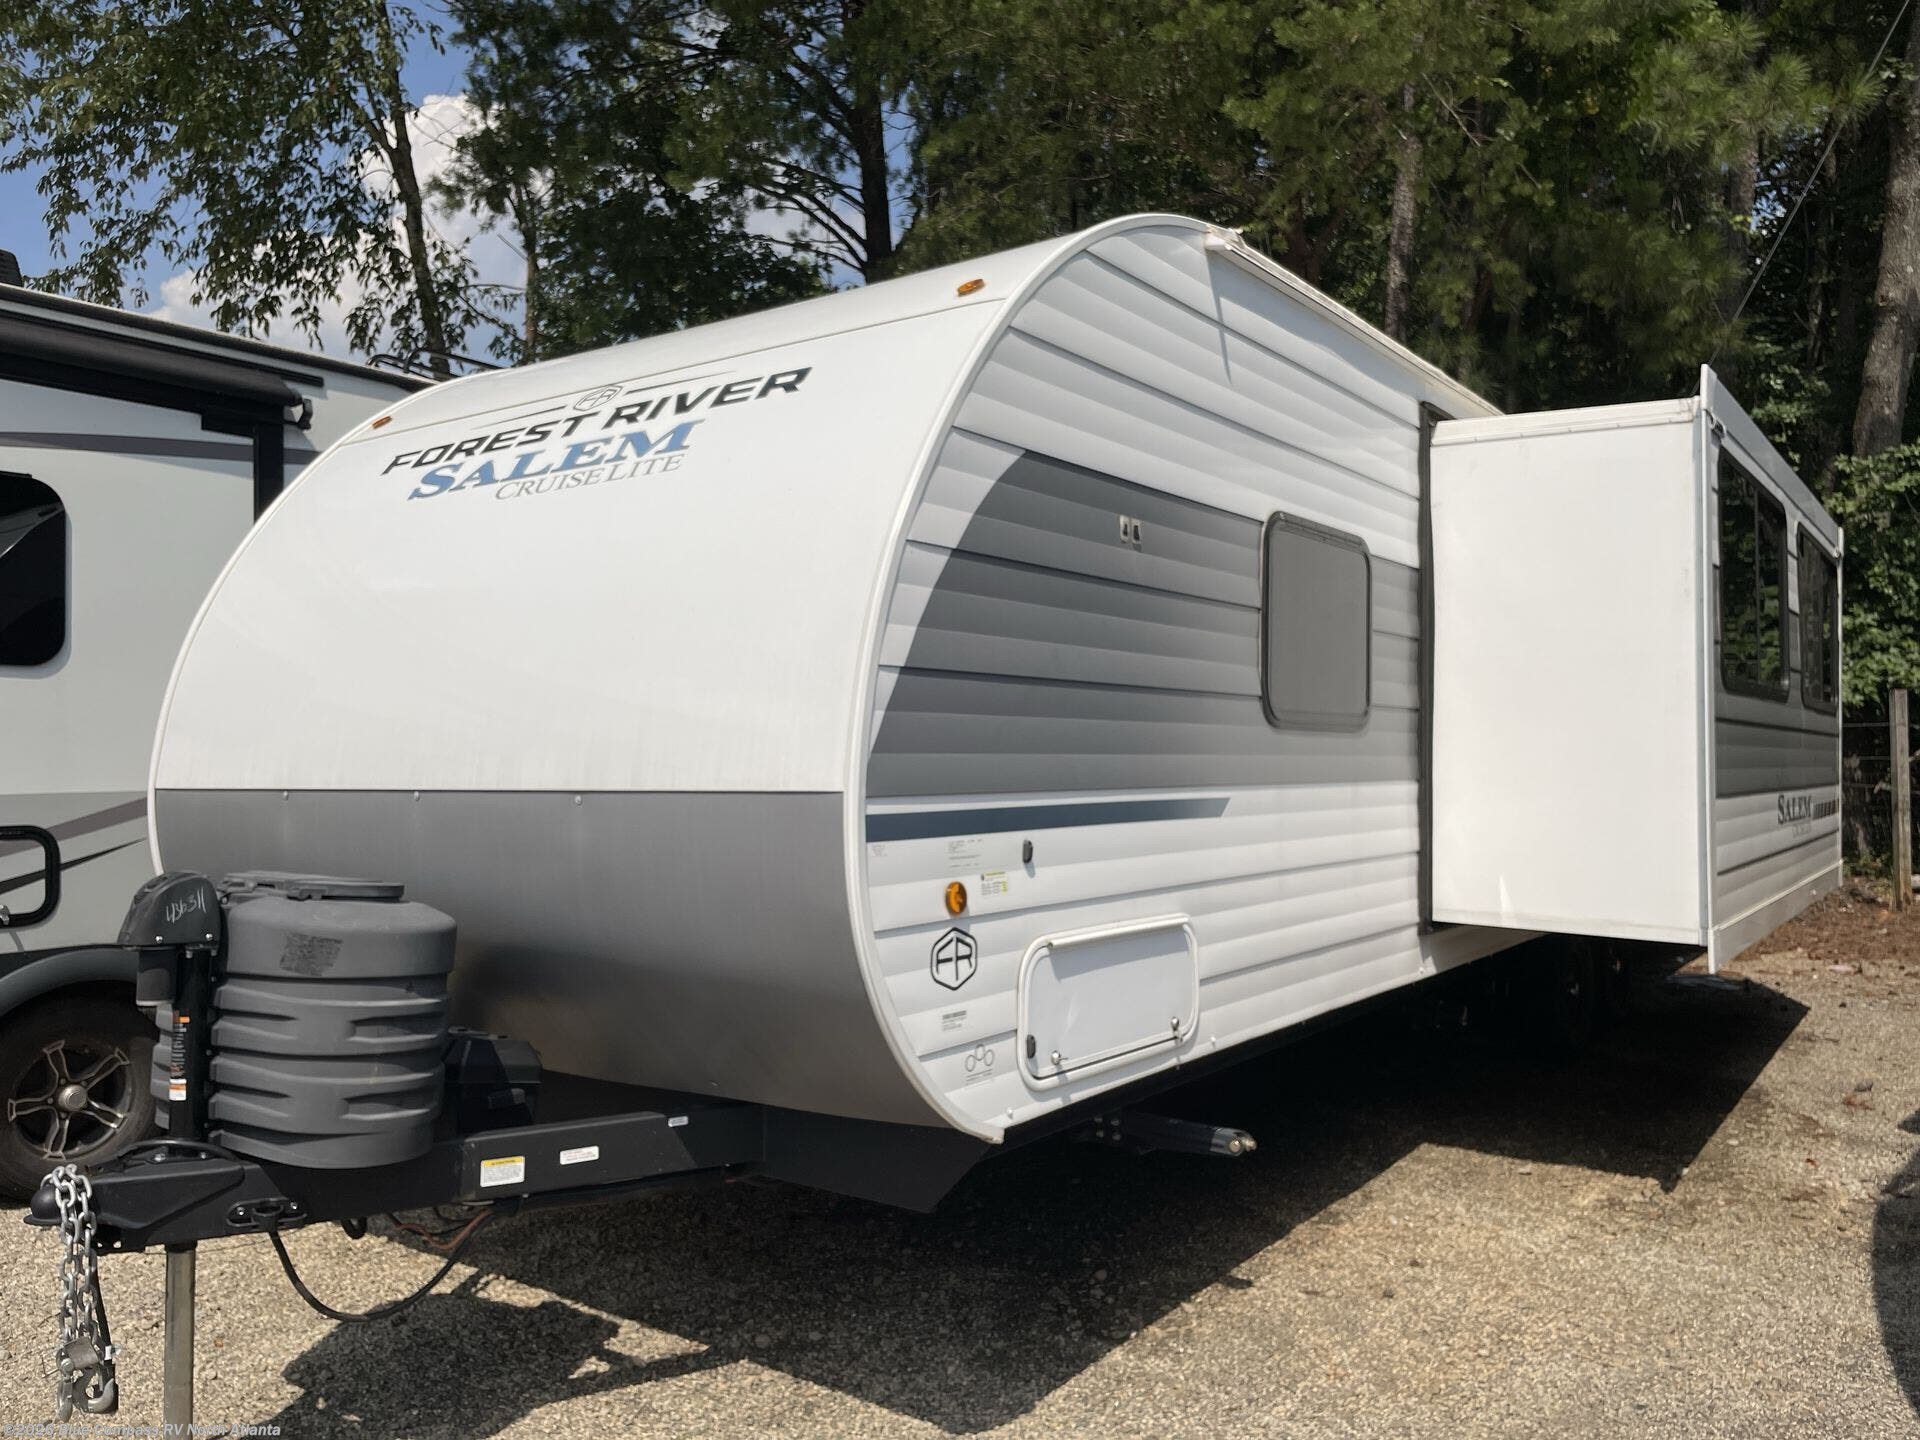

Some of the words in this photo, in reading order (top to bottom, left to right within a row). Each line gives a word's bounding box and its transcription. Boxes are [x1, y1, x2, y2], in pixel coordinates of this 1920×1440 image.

[380, 411, 601, 475] FOREST
[601, 366, 813, 430] RIVER
[407, 418, 706, 500] SALEM
[1777, 794, 1811, 824] SALEM
